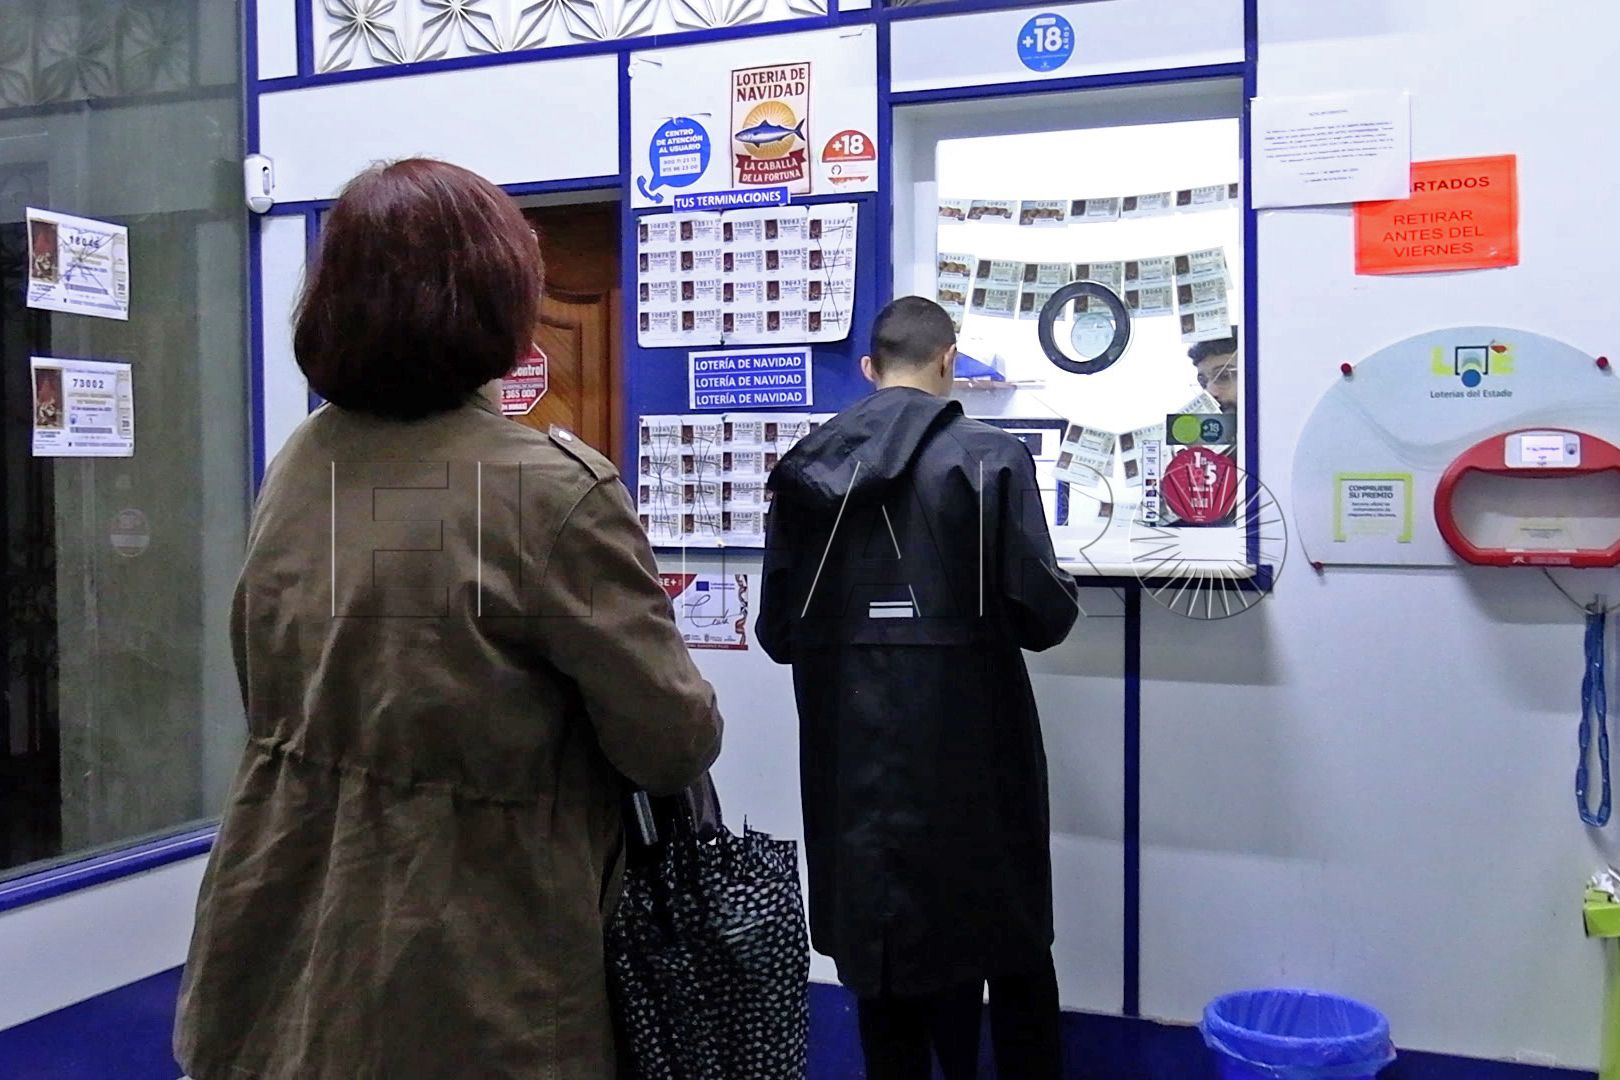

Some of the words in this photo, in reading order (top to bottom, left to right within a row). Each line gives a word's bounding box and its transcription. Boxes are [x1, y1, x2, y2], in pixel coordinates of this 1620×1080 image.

[1022, 26, 1062, 52] +18
[736, 70, 786, 86] LOTERIA
[790, 68, 805, 80] DE
[736, 82, 805, 102] NAVIDAD
[665, 128, 694, 137] CENTRO
[667, 135, 703, 145] ATENCIÓN
[669, 143, 701, 152] USUARIO
[832, 134, 864, 155] +18
[744, 162, 755, 171] LA
[758, 157, 798, 171] CABALLA
[742, 173, 753, 182] DE
[753, 172, 764, 181] LA
[764, 169, 801, 181] FORTUNA
[1410, 176, 1490, 192] RTADOS
[675, 197, 694, 208] TUS
[697, 191, 781, 206] TERMINACIONES
[1393, 210, 1473, 226] RETIRAR
[1383, 227, 1443, 242] ANTES
[1448, 225, 1485, 239] DEL
[1393, 242, 1474, 258] VIERNES
[696, 357, 736, 371] LOTERÍA
[738, 359, 751, 369] DE
[753, 357, 801, 368] NAVIDAD
[73, 378, 104, 389] 73002
[696, 375, 736, 388] LOTERÍA
[738, 376, 751, 386] DE
[753, 374, 802, 386] NAVIDAD
[696, 392, 736, 405] LOTERÍA
[739, 393, 752, 404] DE
[754, 392, 802, 403] NAVIDAD
[1466, 390, 1481, 398] del
[1483, 389, 1513, 398] Estado
[1205, 464, 1217, 485] 5
